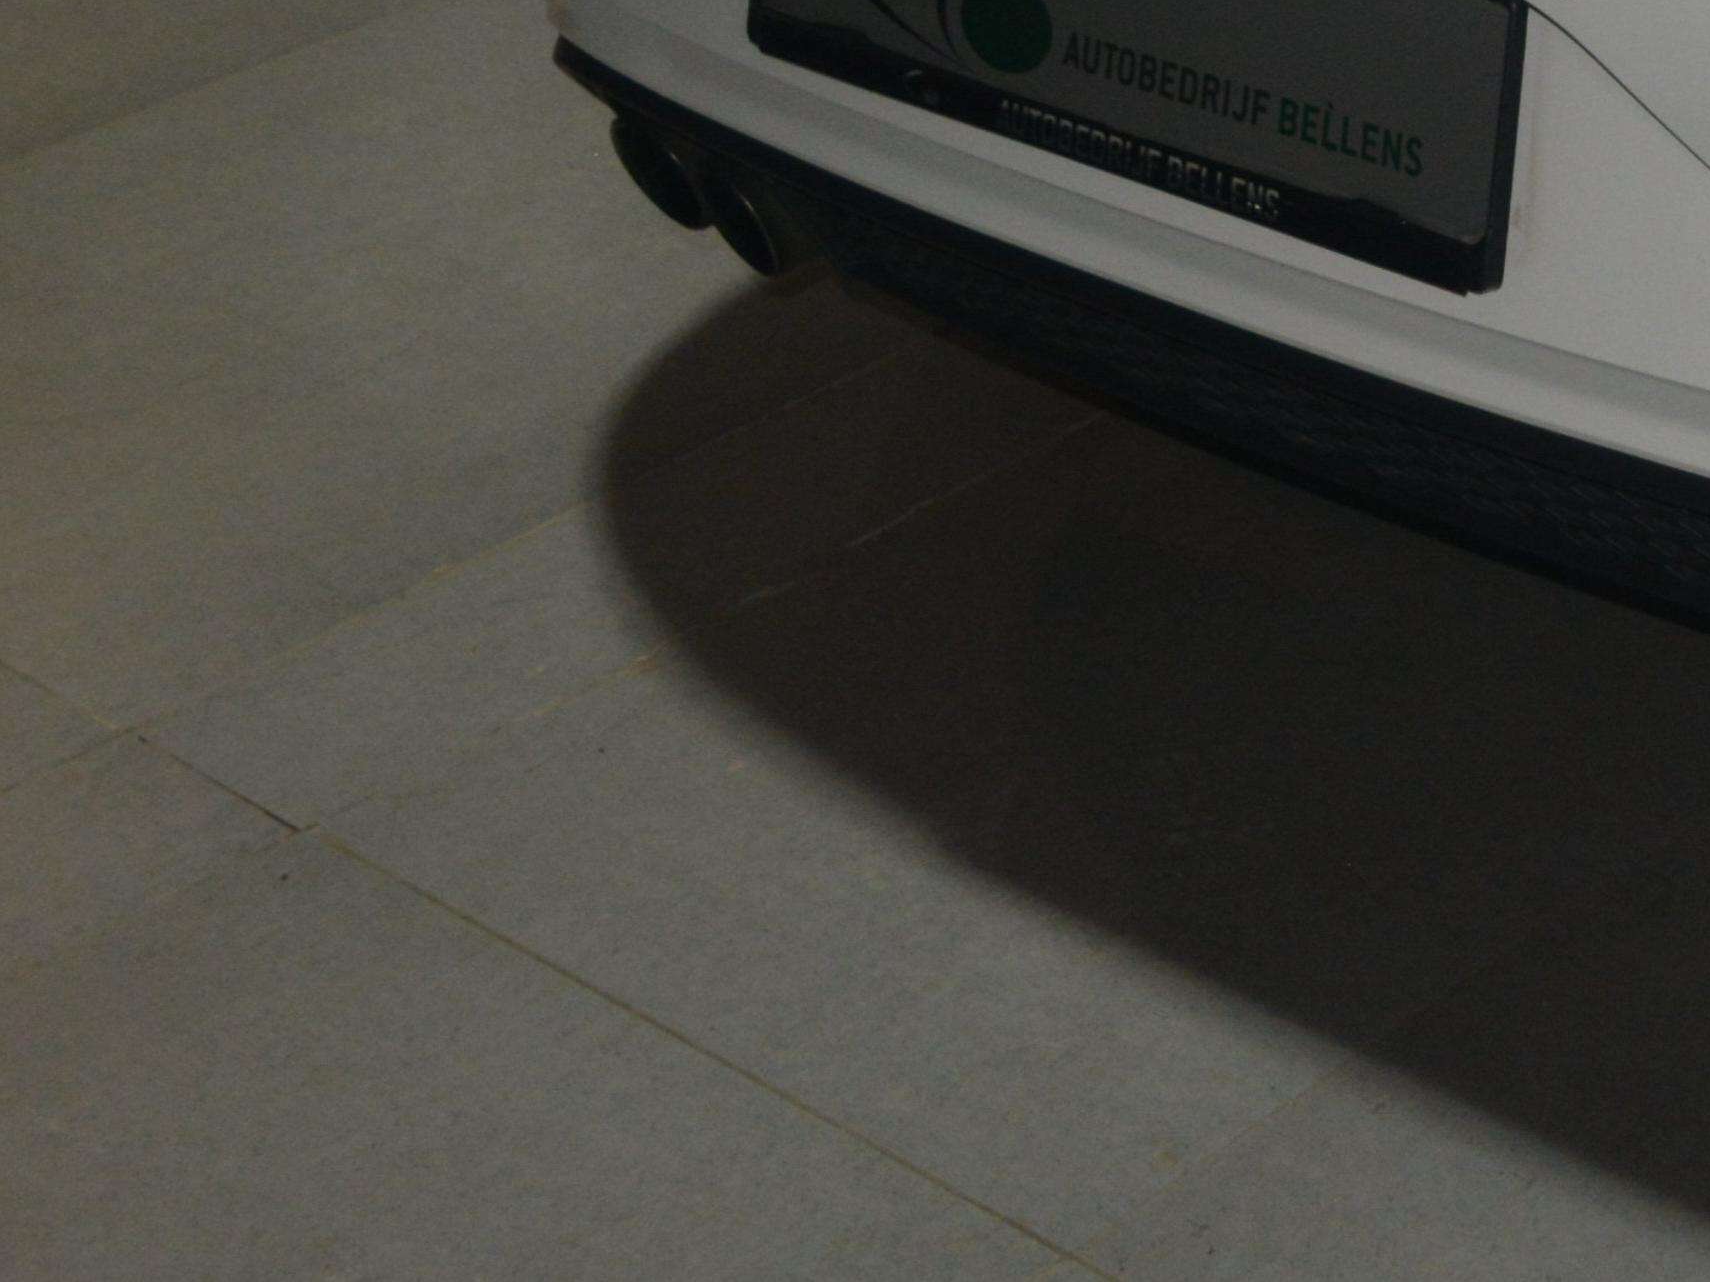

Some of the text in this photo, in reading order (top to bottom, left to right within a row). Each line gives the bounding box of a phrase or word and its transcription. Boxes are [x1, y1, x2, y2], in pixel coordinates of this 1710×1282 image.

[998, 97, 1282, 221] AUTOBEDRIJF BELLENS
[1063, 33, 1424, 178] AUTOBEDRIJF BELLENS
